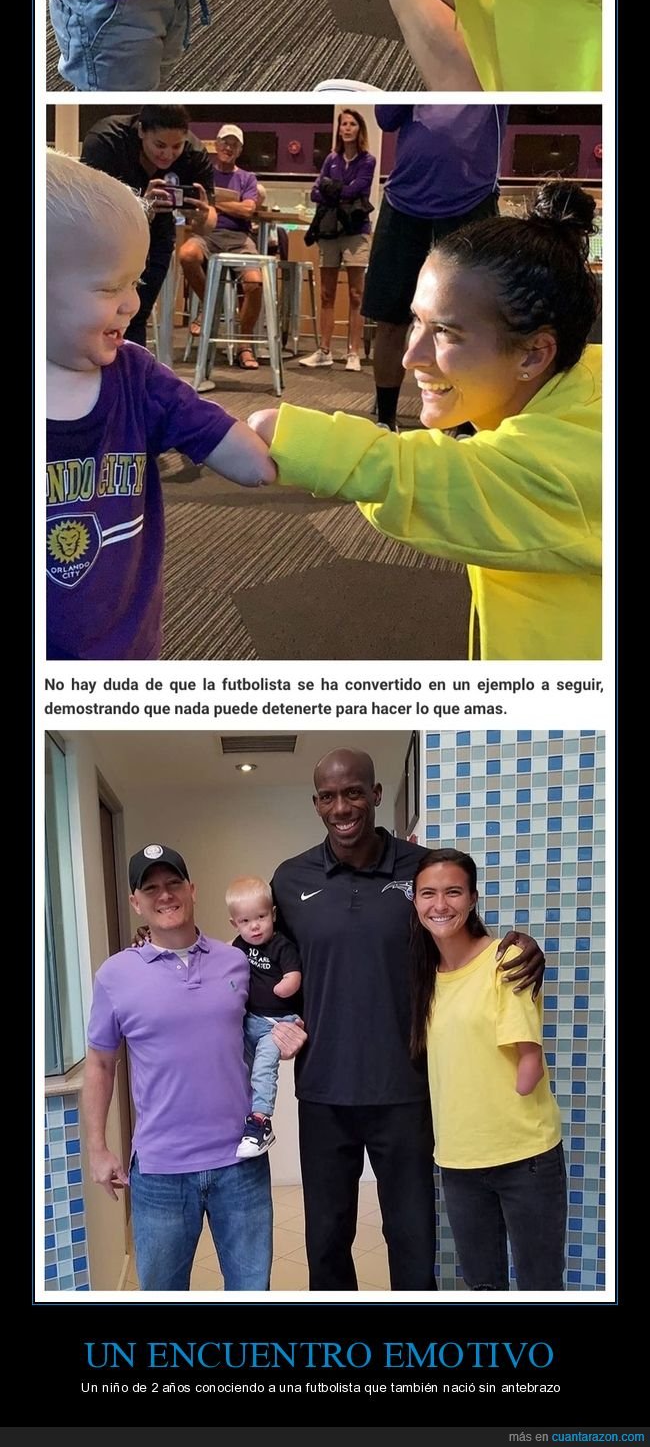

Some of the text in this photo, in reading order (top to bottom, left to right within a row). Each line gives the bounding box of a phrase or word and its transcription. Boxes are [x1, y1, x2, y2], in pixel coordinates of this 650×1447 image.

[97, 452, 147, 498] CITY
[50, 561, 90, 575] ORLANDO
[62, 570, 81, 580] CITY
